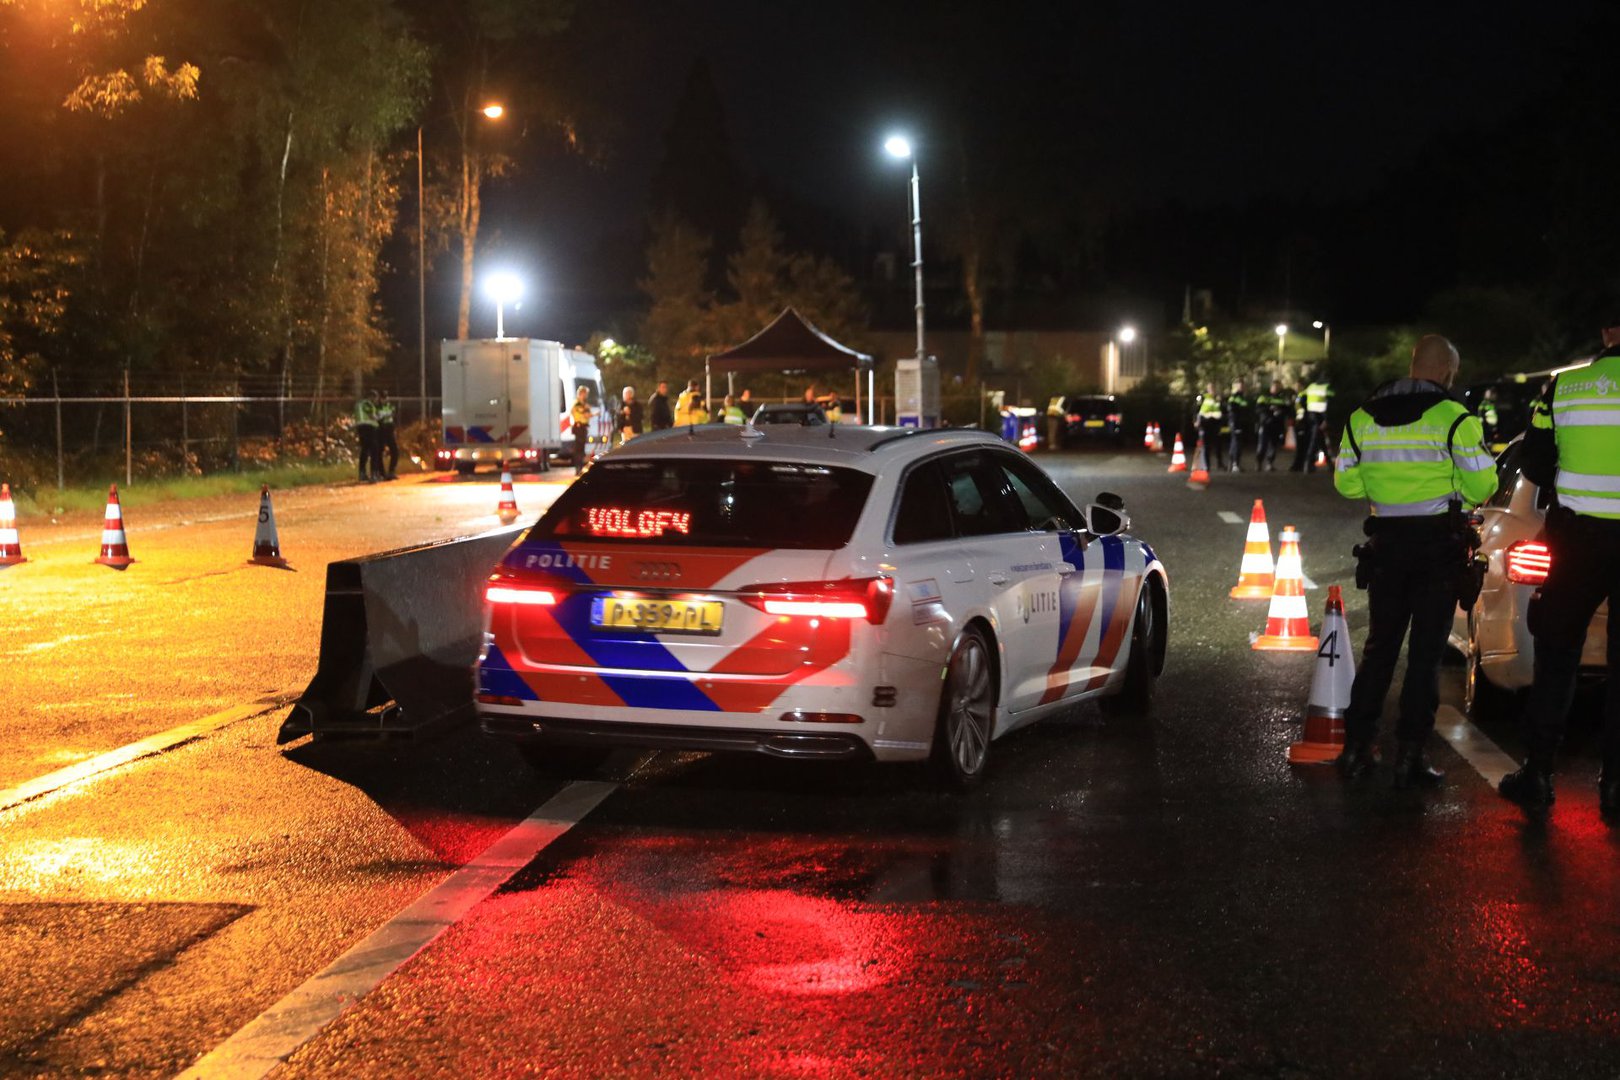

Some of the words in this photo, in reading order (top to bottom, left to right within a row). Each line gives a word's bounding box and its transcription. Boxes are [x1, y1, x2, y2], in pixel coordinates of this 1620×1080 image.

[259, 506, 269, 523] 5
[525, 554, 612, 569] POLITIE
[1318, 630, 1340, 667] 4
